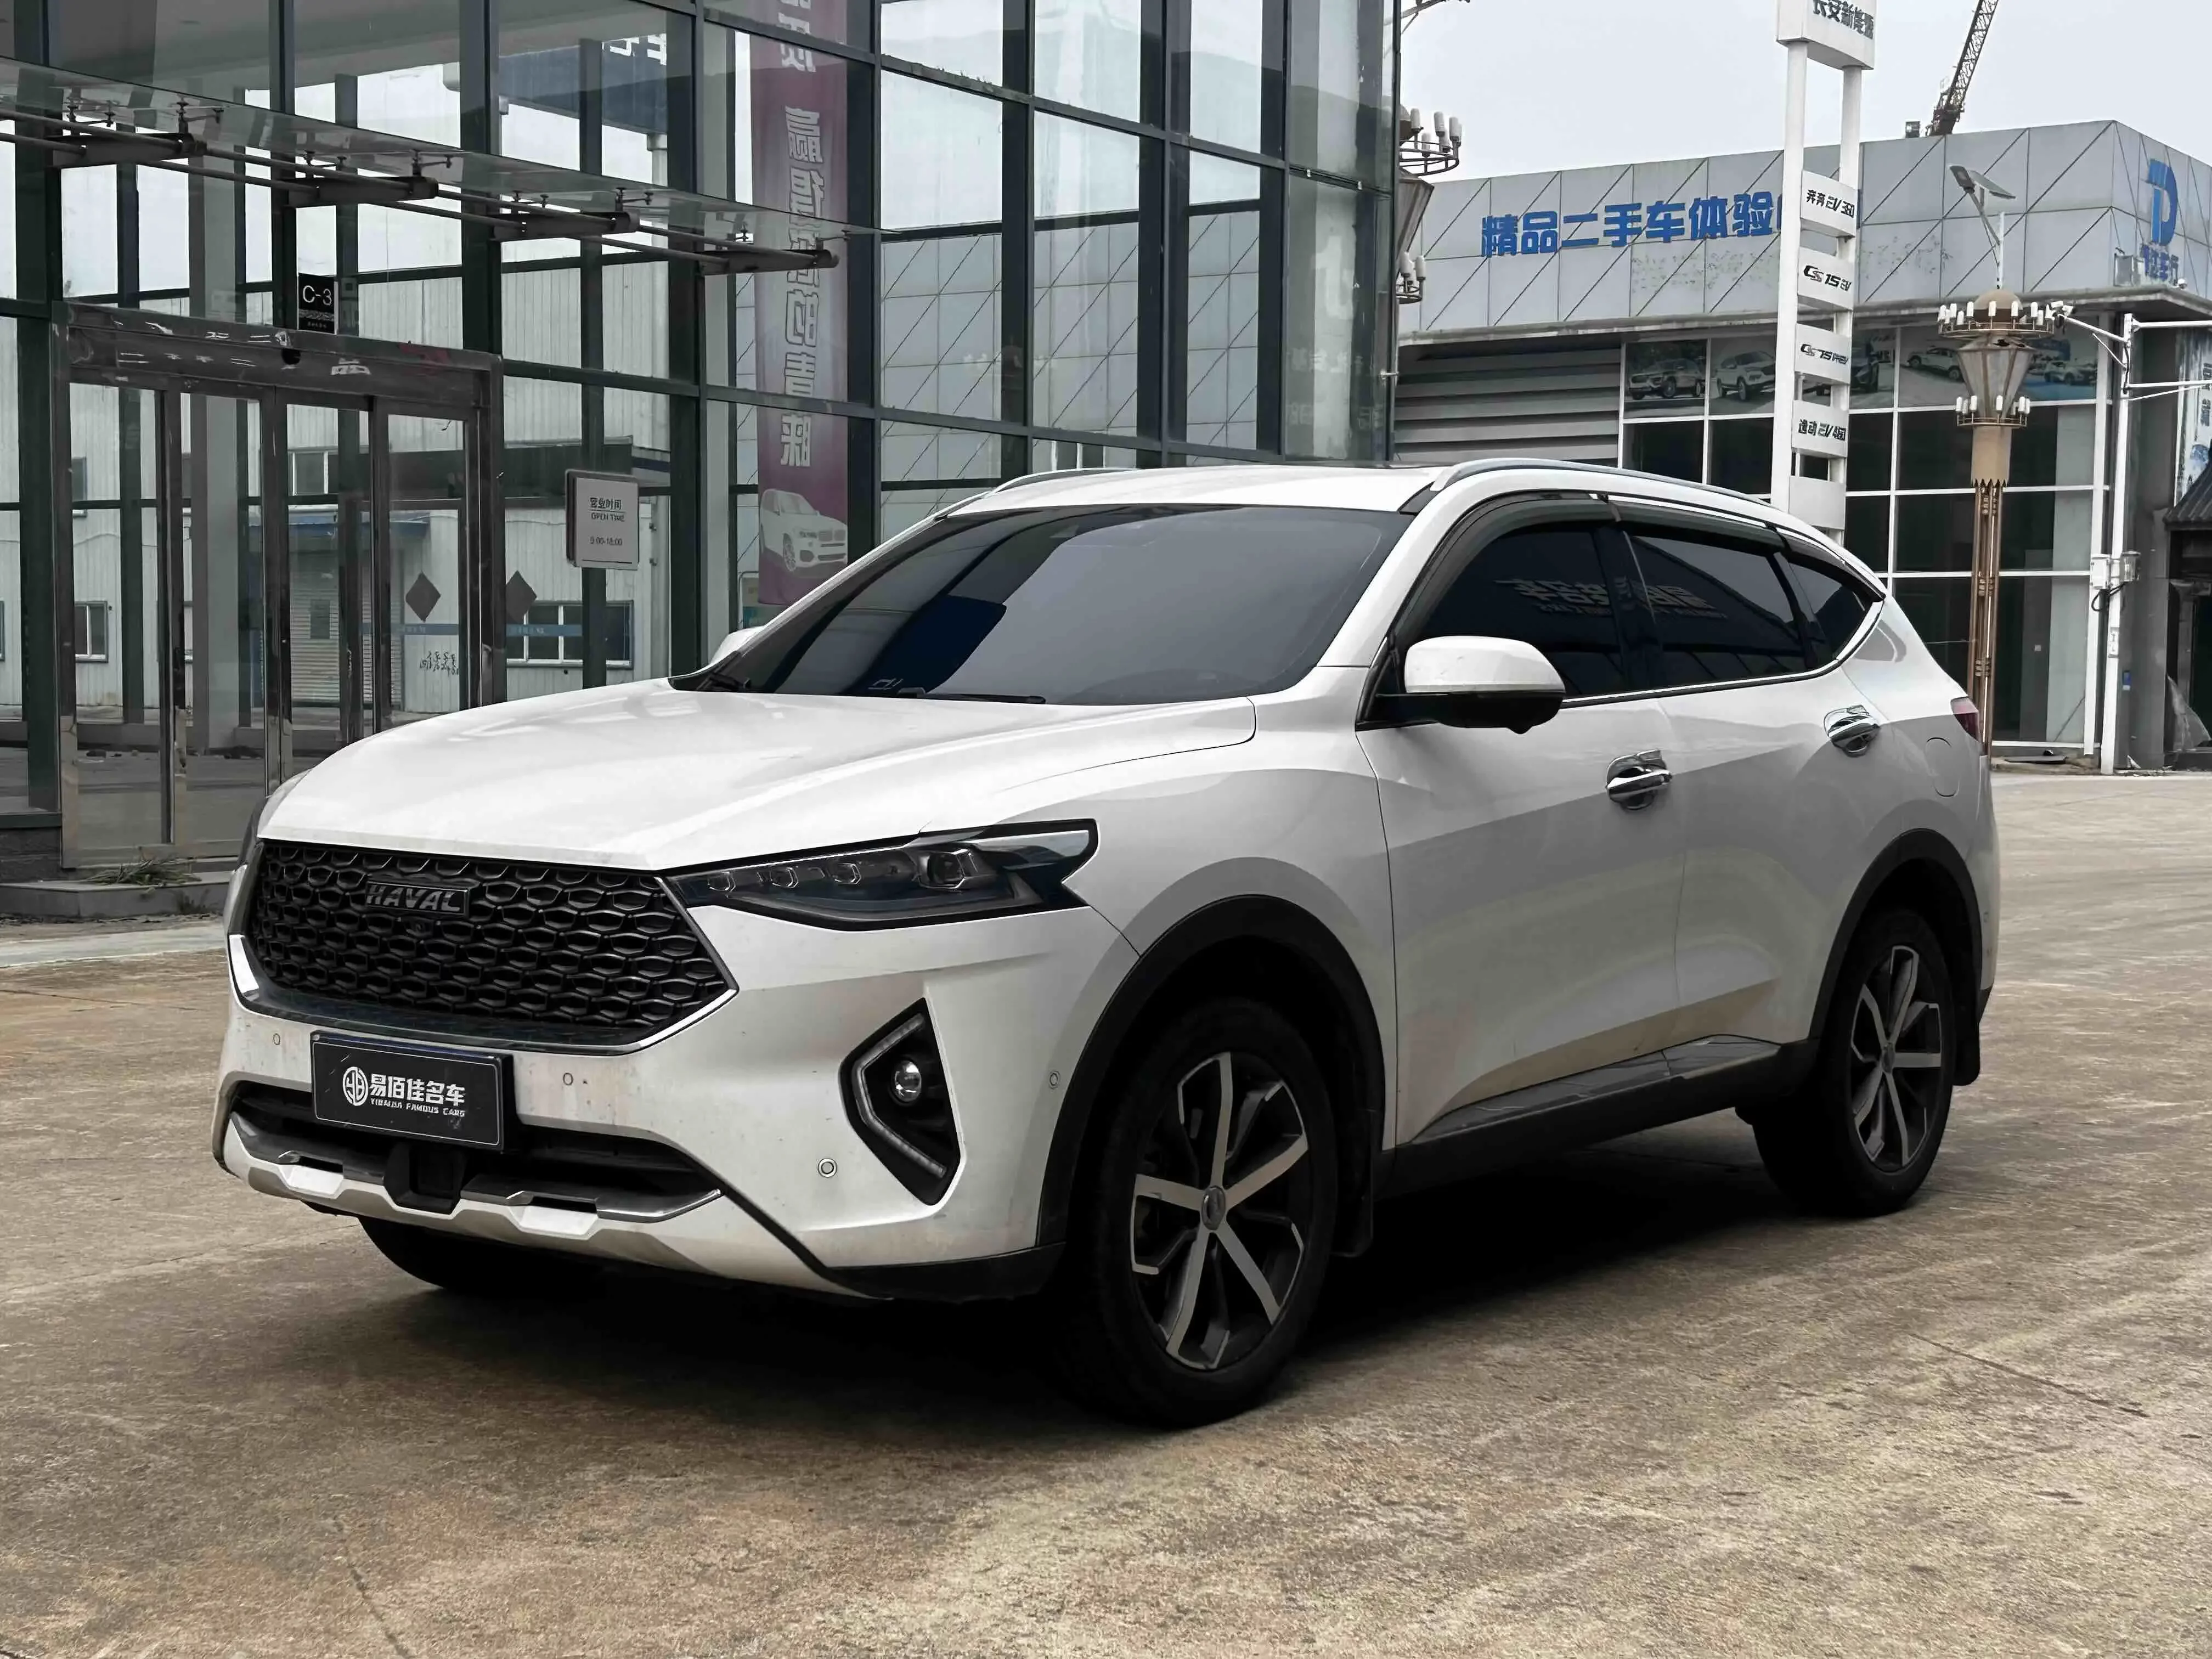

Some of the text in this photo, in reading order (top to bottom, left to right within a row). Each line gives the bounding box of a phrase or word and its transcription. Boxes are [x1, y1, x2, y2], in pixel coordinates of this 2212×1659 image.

[1481, 191, 1781, 257] 精品二手车体验
[302, 285, 332, 306] C-3
[366, 885, 461, 912] HAVAL
[369, 1074, 466, 1107] 易佰佳名车
